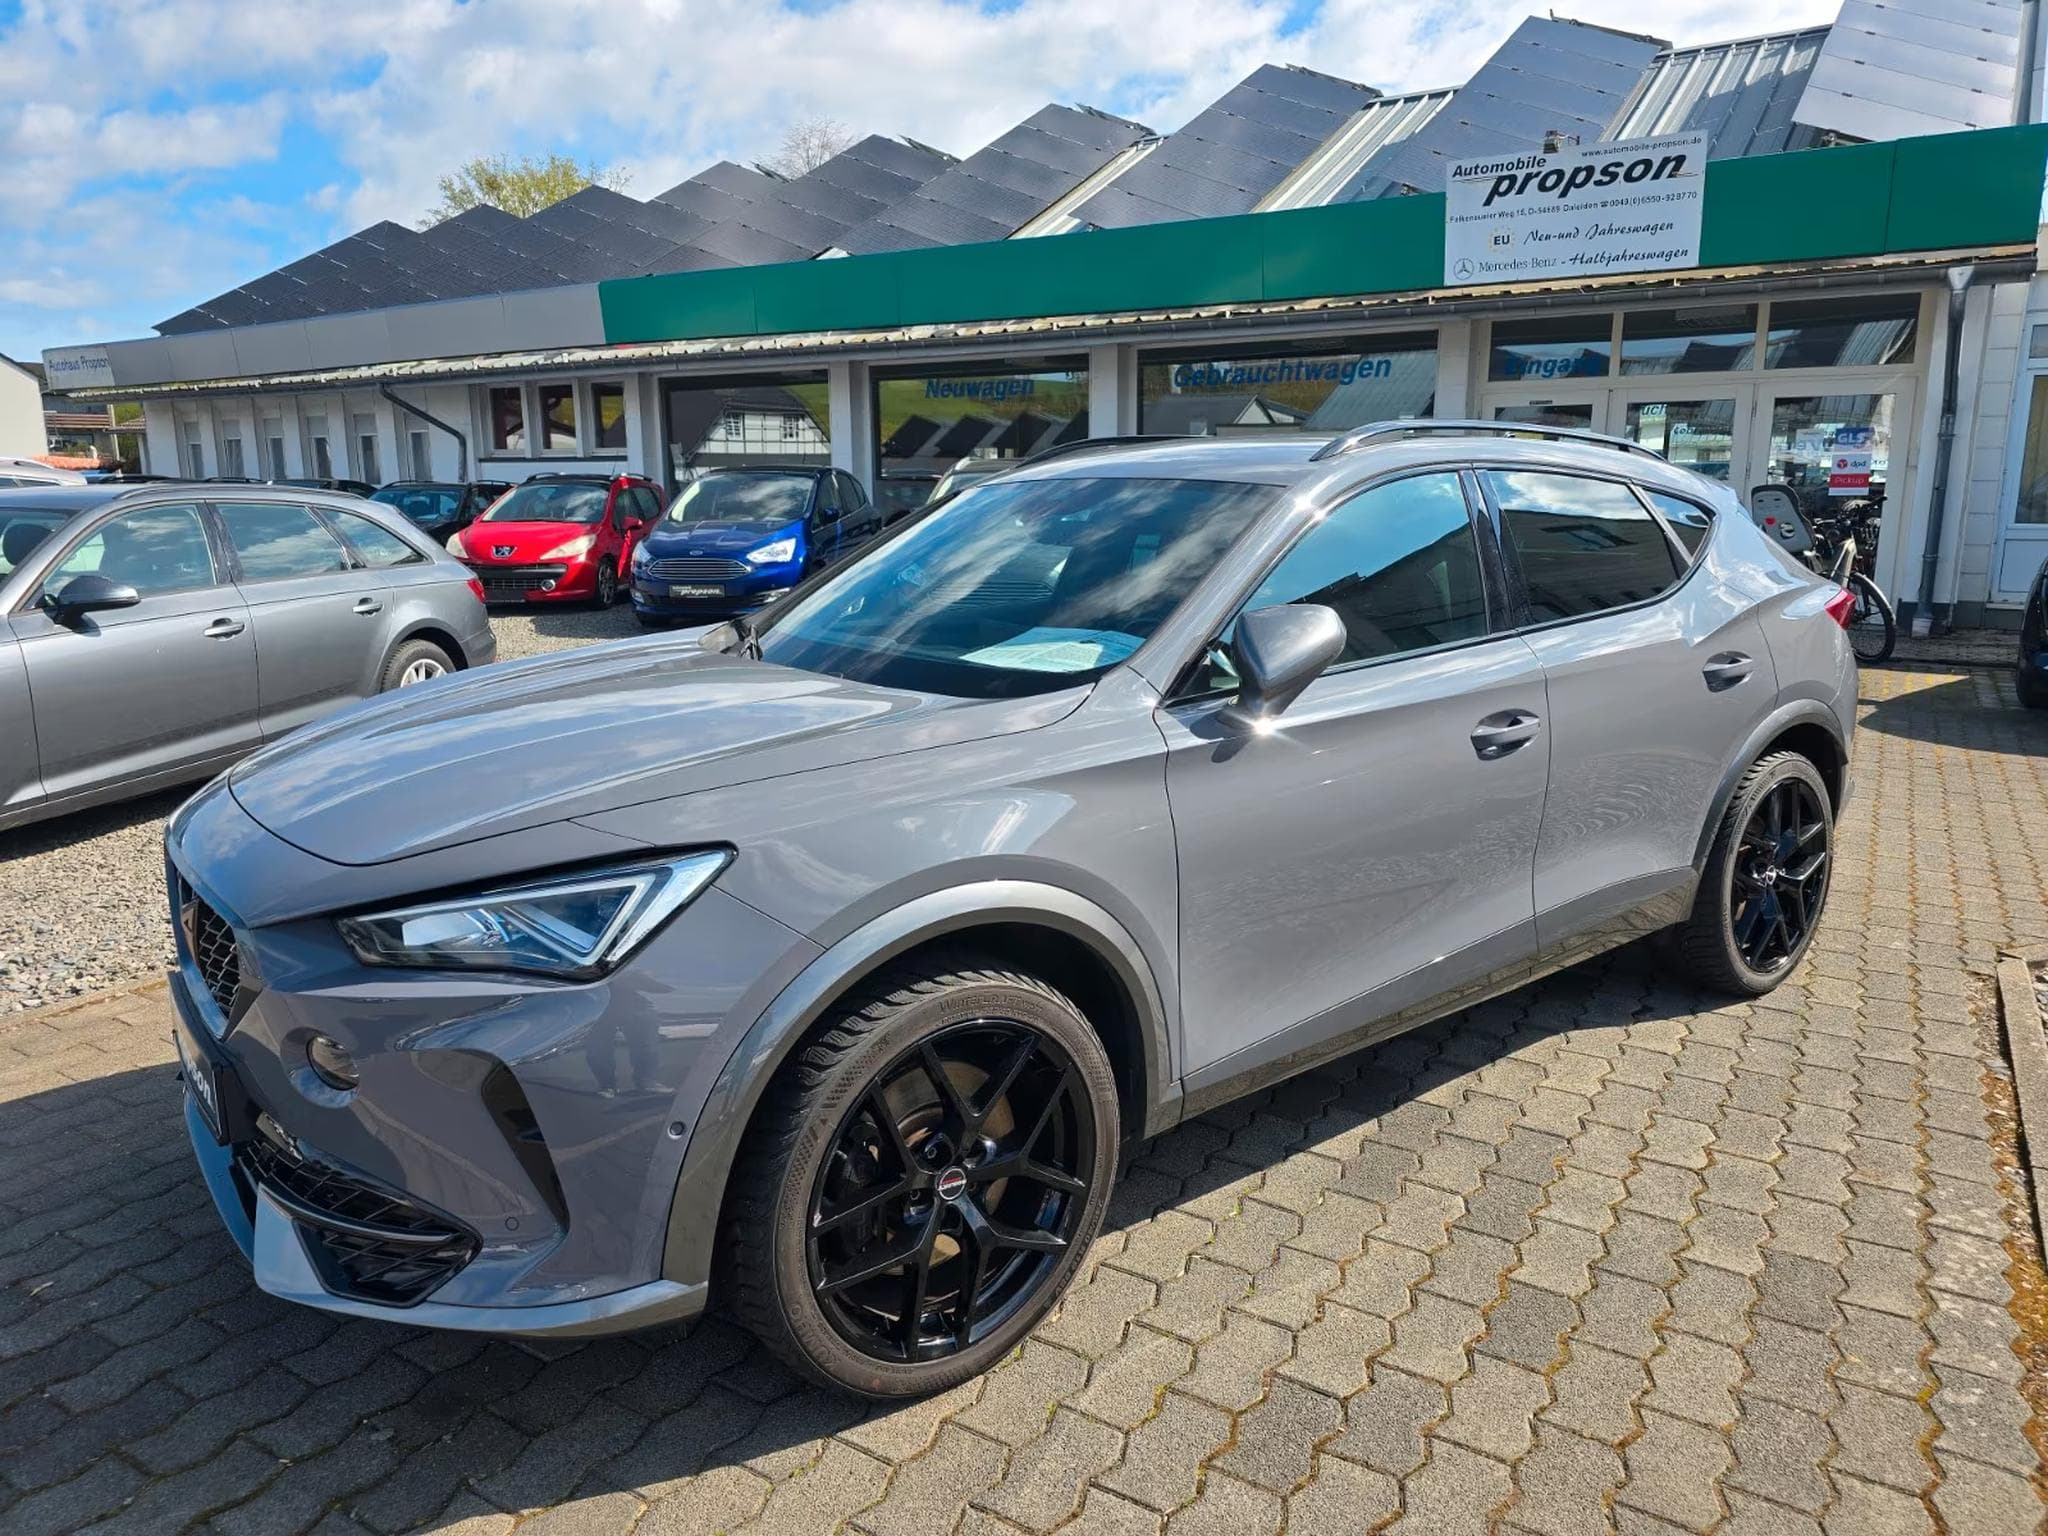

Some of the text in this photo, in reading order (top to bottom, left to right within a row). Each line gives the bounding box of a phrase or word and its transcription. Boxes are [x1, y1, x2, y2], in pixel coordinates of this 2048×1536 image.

[1452, 155, 1547, 178] Automobile
[1482, 154, 1687, 207] propson
[1493, 234, 1511, 246] EU
[1585, 222, 1674, 240] Jahreswagen
[1174, 358, 1391, 388] Gebrauchtwagen
[925, 377, 1035, 401] Neuwagen
[1837, 431, 1867, 444] GLS
[1850, 459, 1867, 471] dpd
[1834, 475, 1866, 485] Pickup
